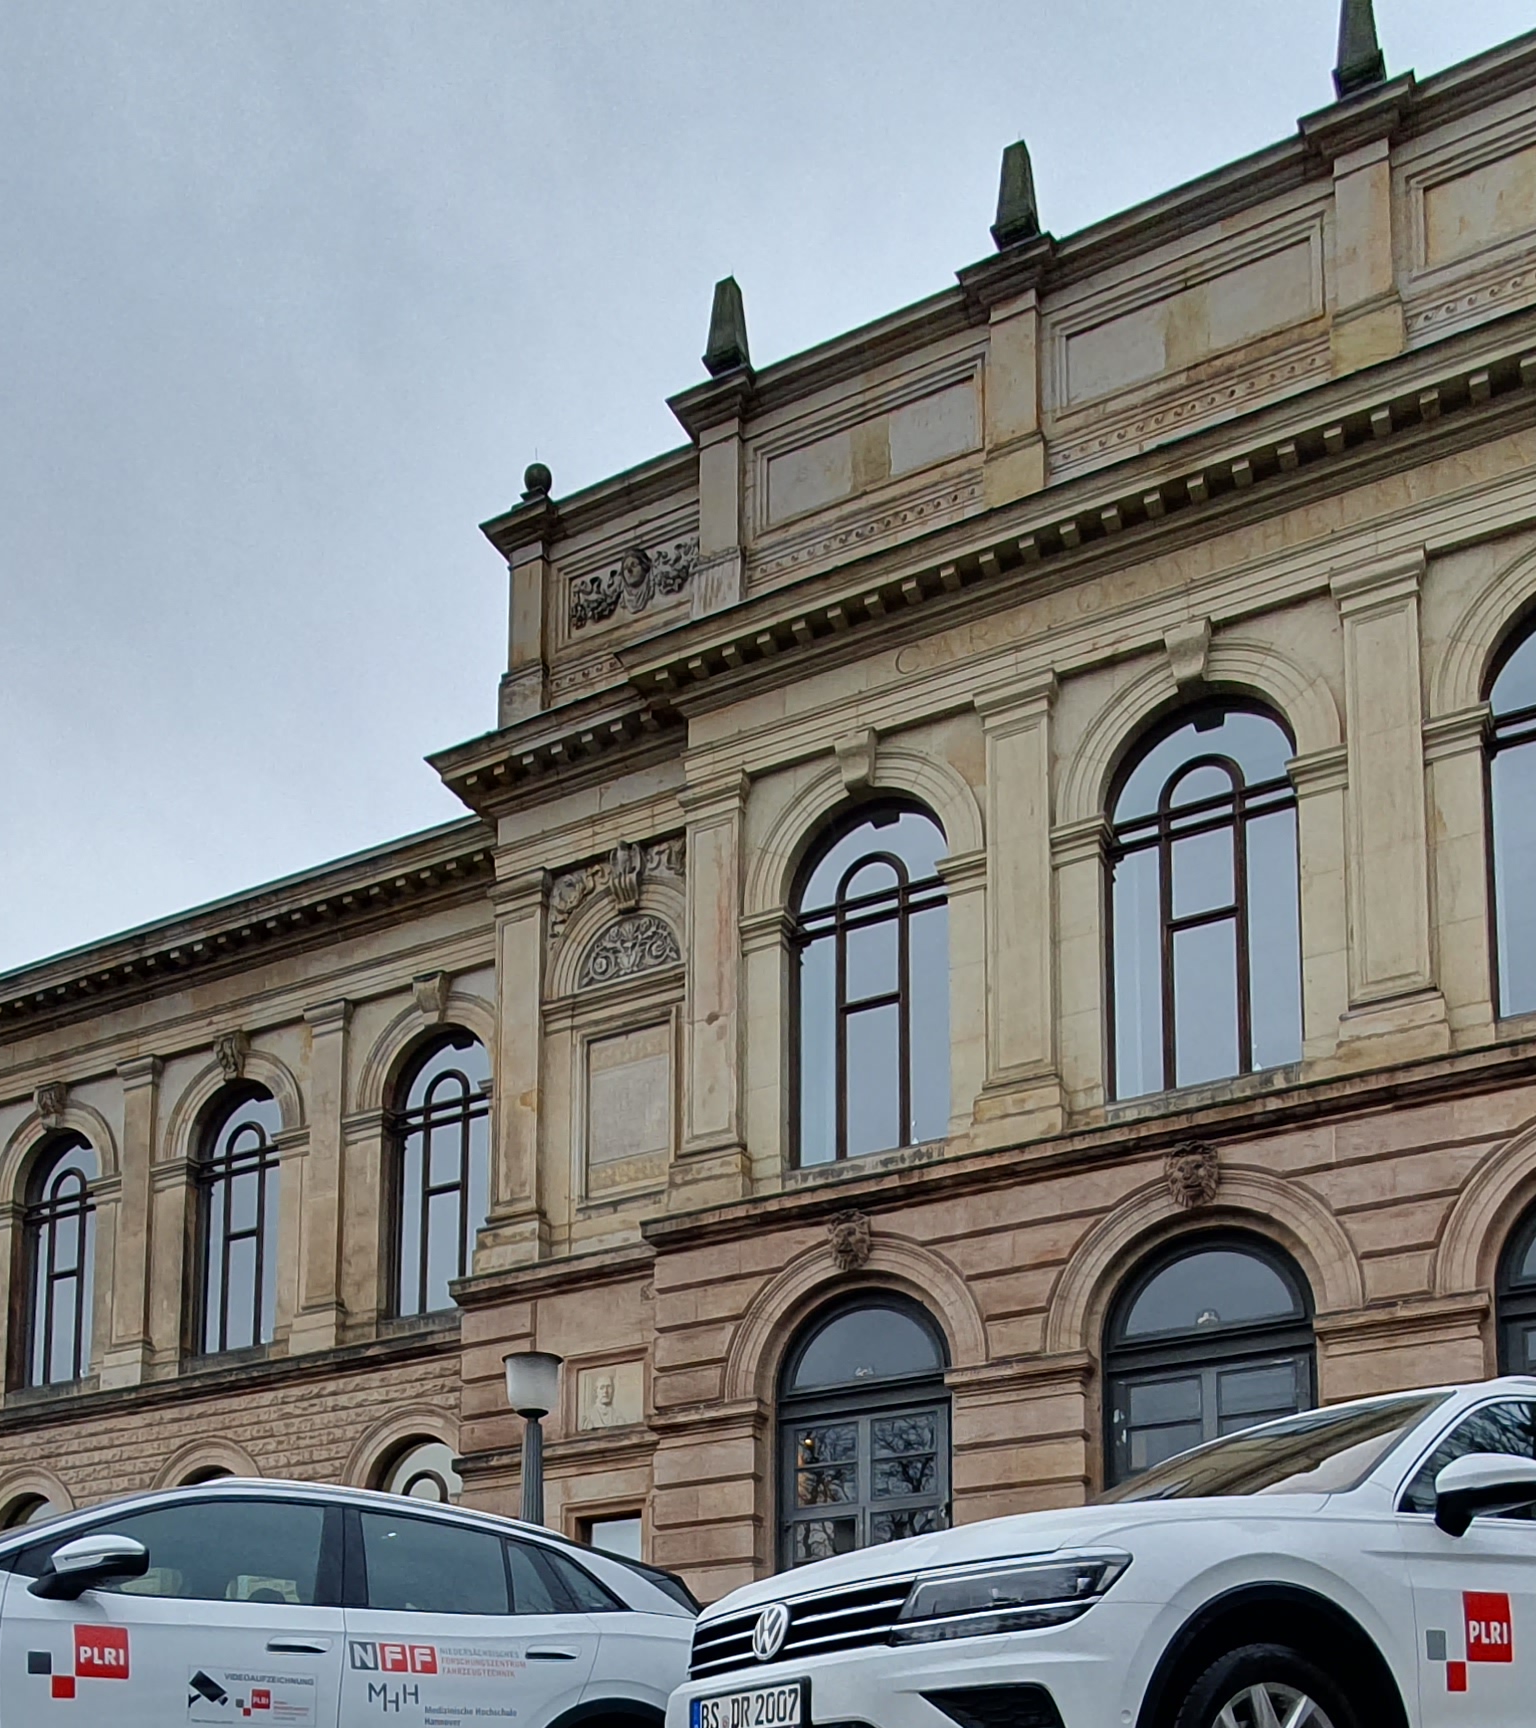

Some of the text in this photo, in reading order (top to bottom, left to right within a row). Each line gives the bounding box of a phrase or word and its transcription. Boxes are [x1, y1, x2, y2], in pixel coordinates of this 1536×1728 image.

[1468, 1620, 1508, 1645] PLRI
[79, 1646, 125, 1666] PLRI
[350, 1641, 437, 1674] NFF
[224, 1673, 314, 1686] VIDEOAUFZEICHNUNG
[368, 1682, 419, 1712] MHH
[754, 1687, 799, 1726] 2007
[424, 1706, 517, 1718] Medizinische Hochschule
[424, 1718, 461, 1727] Hannover
